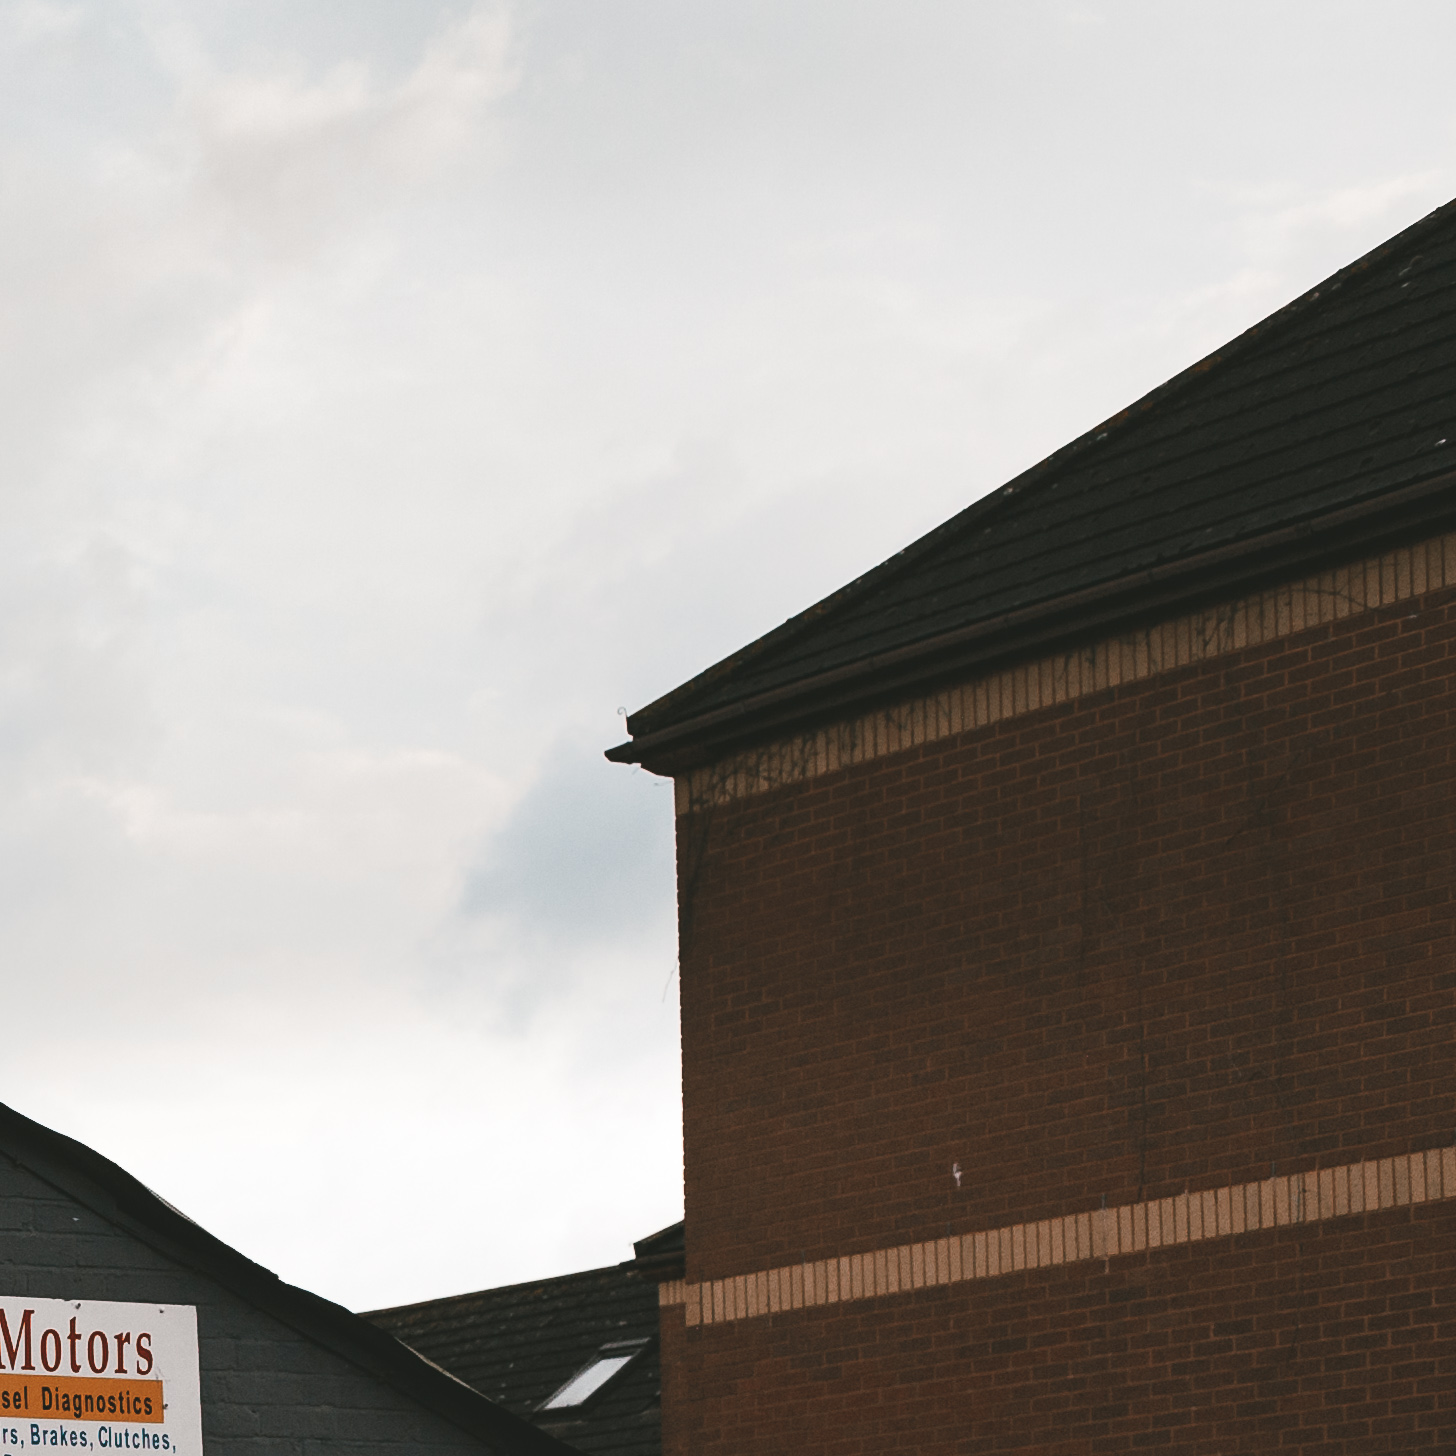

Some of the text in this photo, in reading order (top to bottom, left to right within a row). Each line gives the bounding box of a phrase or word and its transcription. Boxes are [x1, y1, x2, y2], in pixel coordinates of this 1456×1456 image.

[42, 1387, 152, 1418] Diagnostics
[31, 1424, 94, 1450] Brakes,
[98, 1427, 176, 1452] Clutches,
